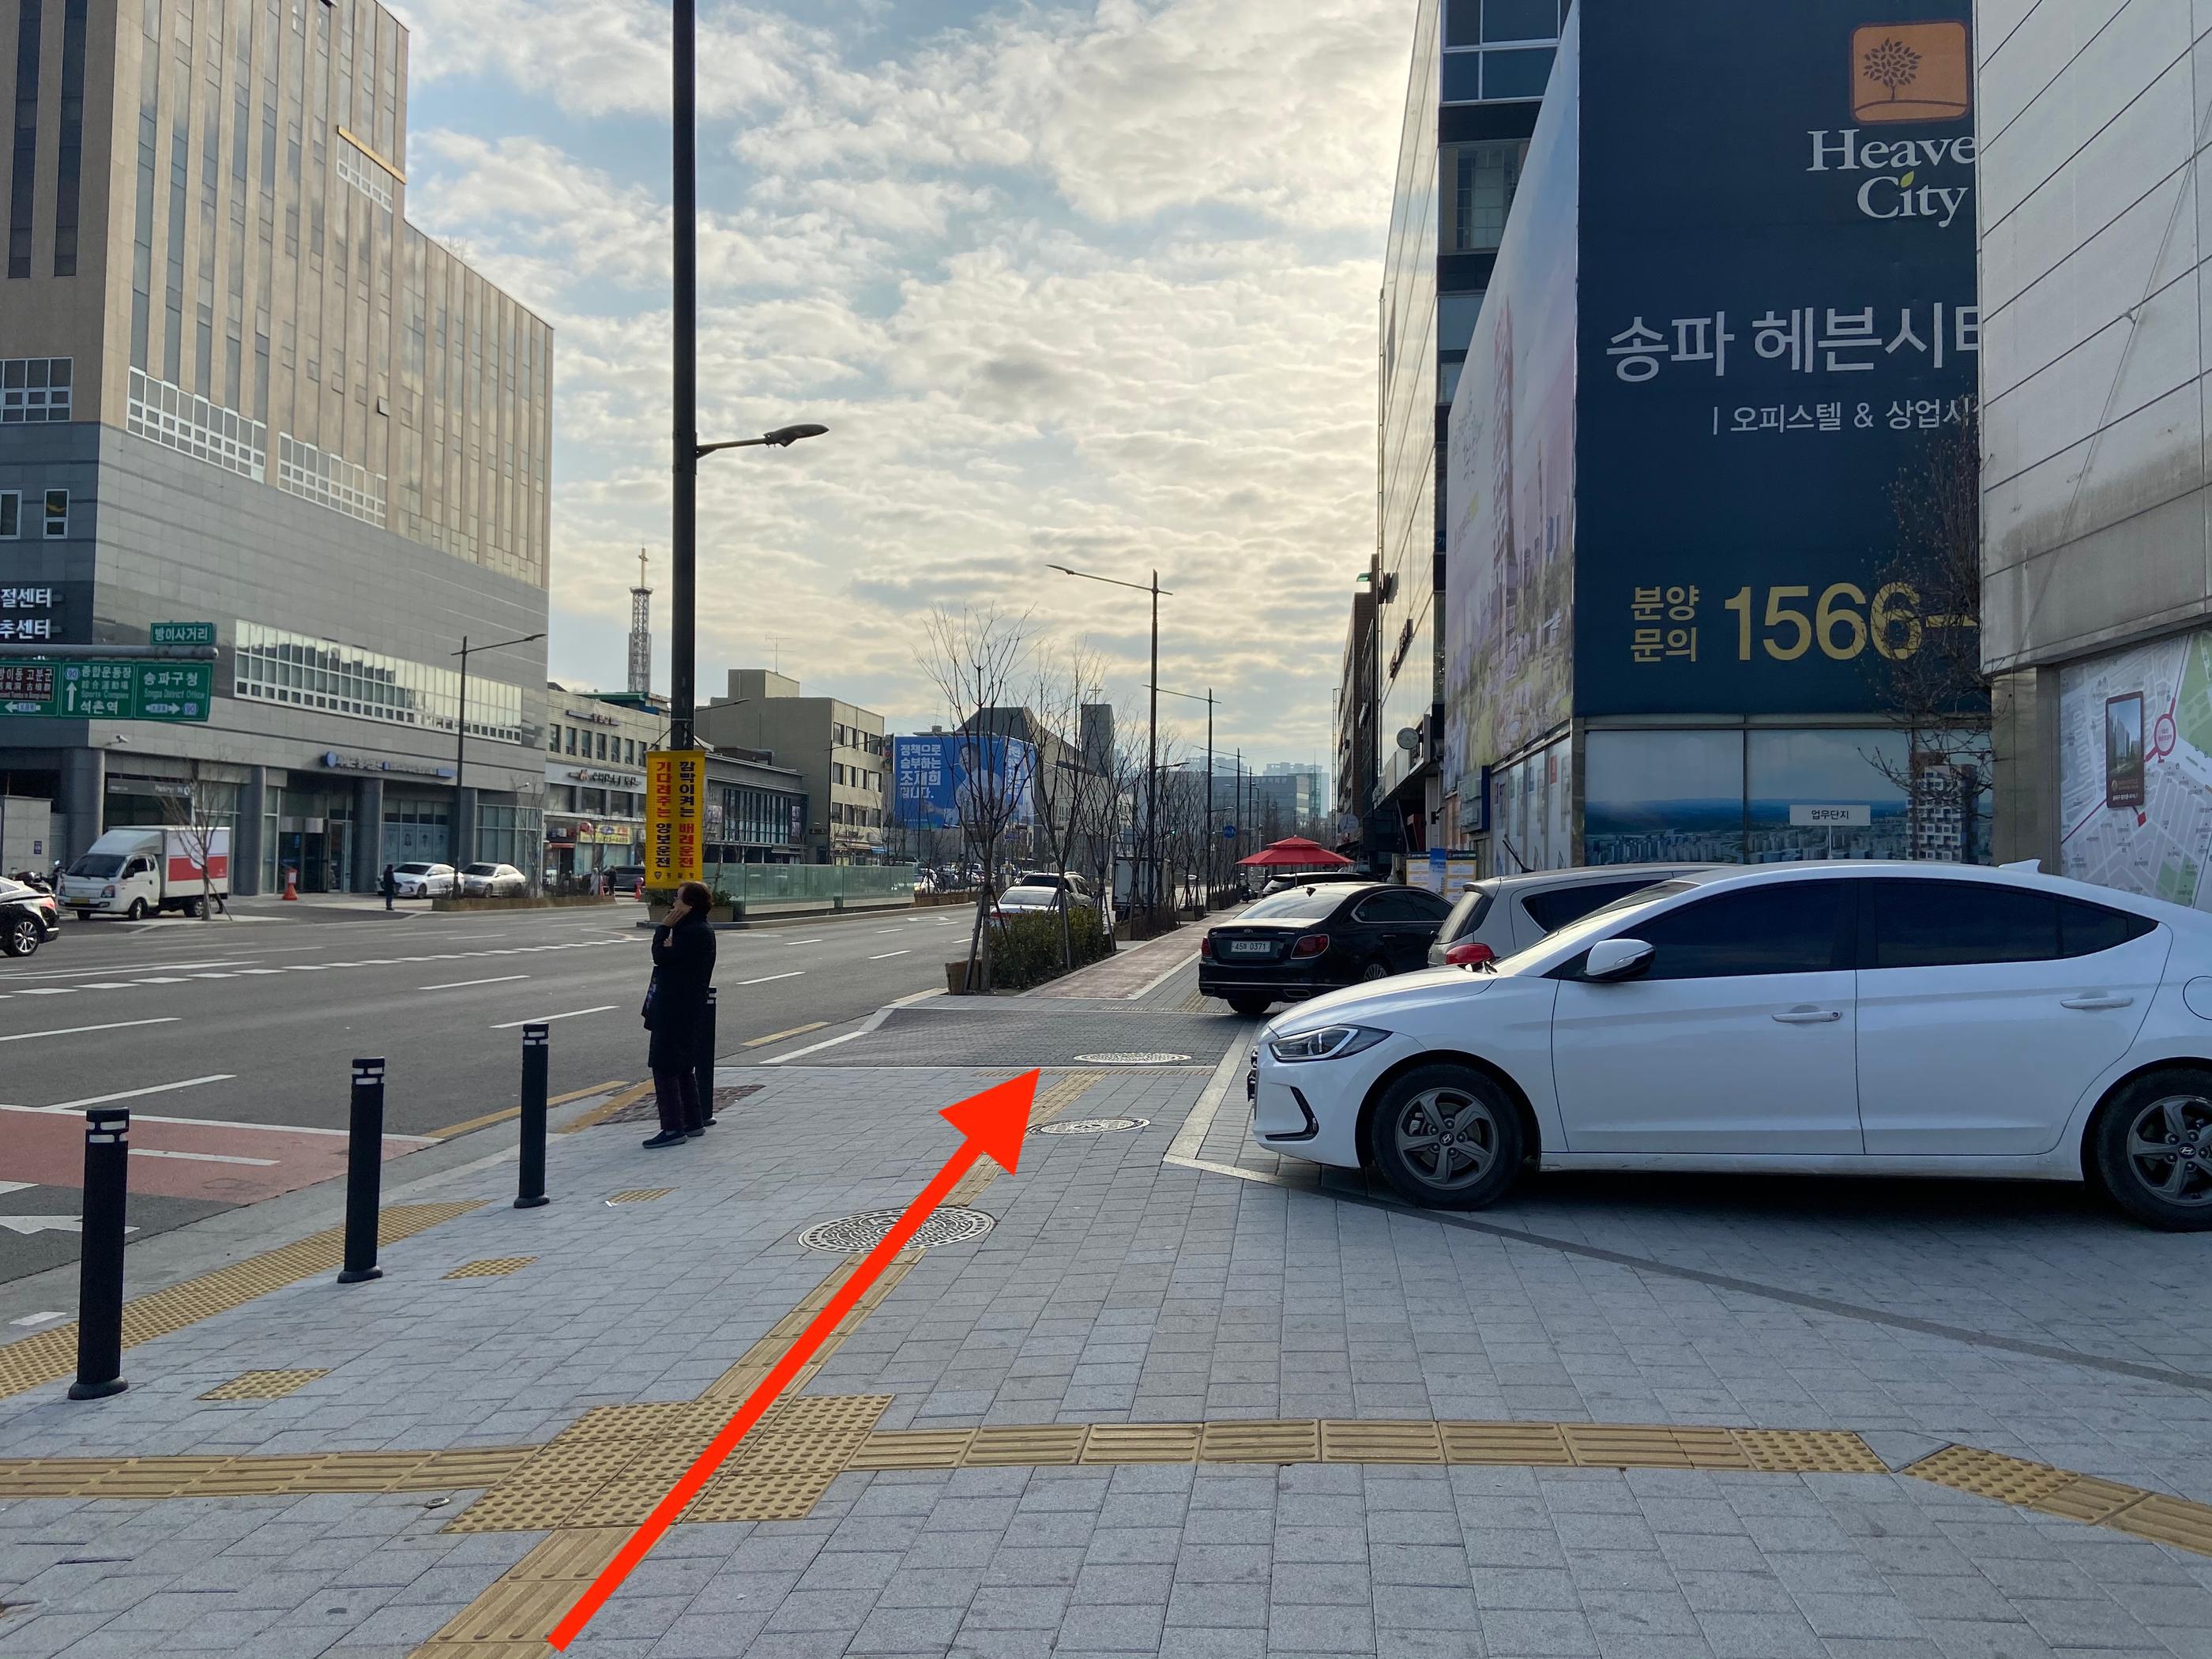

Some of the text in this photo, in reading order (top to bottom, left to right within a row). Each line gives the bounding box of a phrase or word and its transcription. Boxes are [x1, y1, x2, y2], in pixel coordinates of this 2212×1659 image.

[1856, 171, 1969, 228] City
[1606, 310, 1735, 382] 송파
[1730, 397, 1978, 433] 오피스텔 & 상업시
[1, 588, 52, 608] 절센터
[1631, 585, 1699, 622] 분양
[0, 619, 51, 639] 추센터
[154, 627, 209, 641] 방이사거리
[1631, 627, 1697, 663] 문의
[26, 668, 53, 682] 고분군
[81, 665, 132, 679] 종합운동장
[144, 672, 198, 687] 송파구청
[80, 699, 118, 715] 석촌역
[900, 744, 942, 756] 정책으로
[900, 757, 942, 769] 승부하는
[899, 770, 942, 786] 조재희
[655, 762, 672, 868] 기다려주는 양보운전
[1811, 809, 1849, 821] 업무단지
[679, 823, 694, 868] 배려운전
